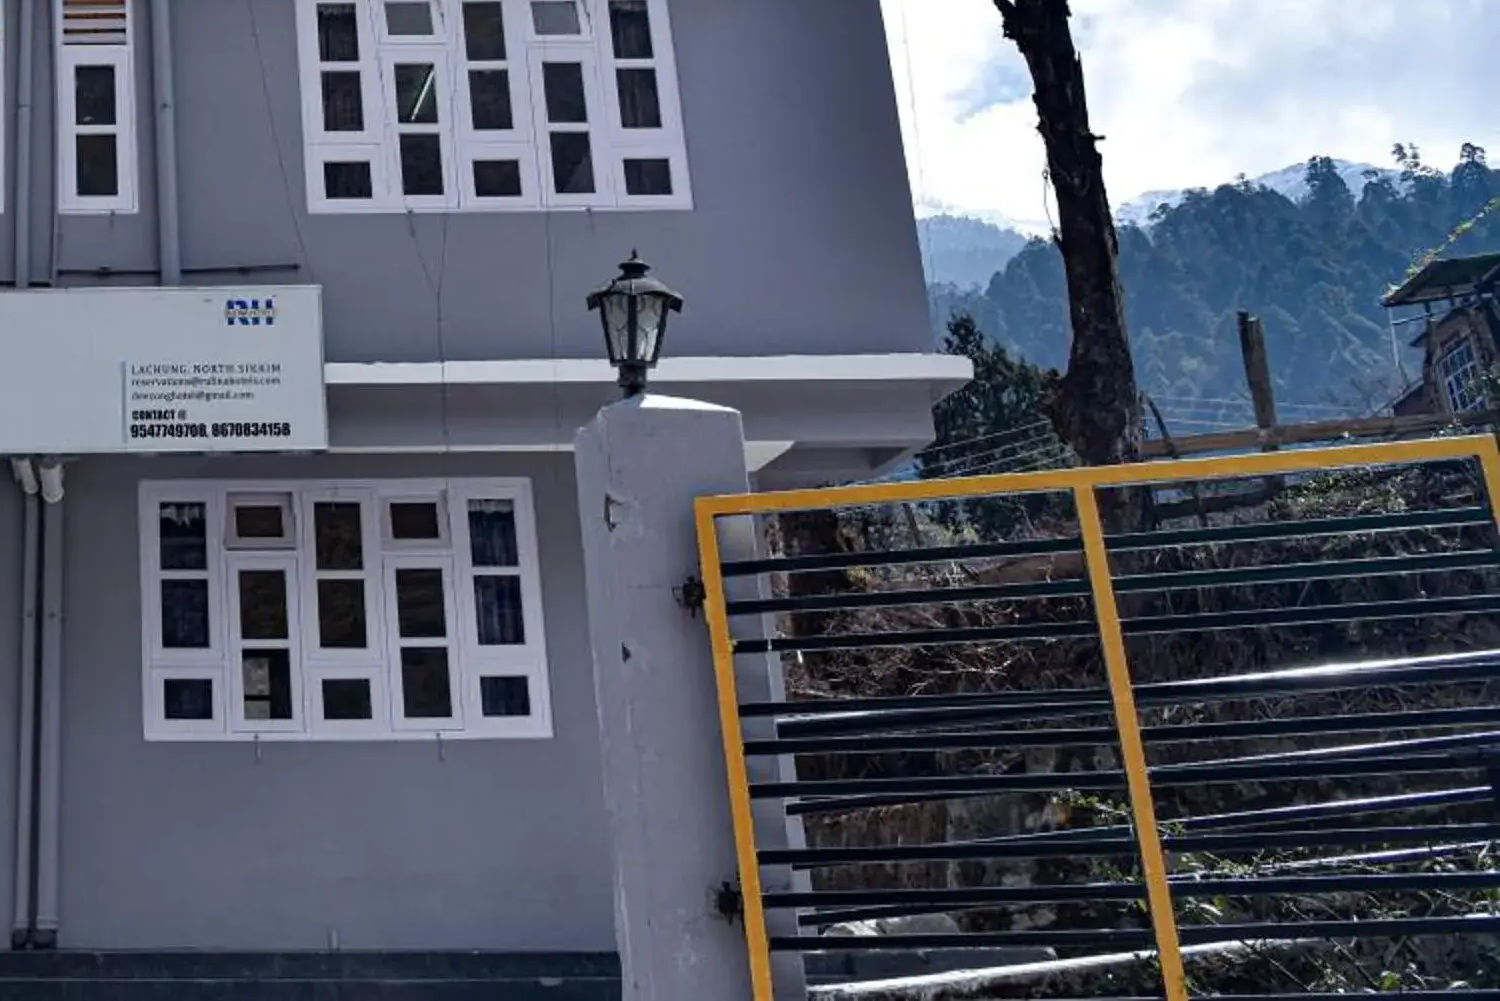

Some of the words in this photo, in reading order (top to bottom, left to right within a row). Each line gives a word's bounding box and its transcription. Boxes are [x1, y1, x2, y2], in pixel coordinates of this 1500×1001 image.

[193, 363, 234, 374] NORTH
[236, 362, 281, 374] SIKKIM
[131, 409, 175, 421] CONTACT
